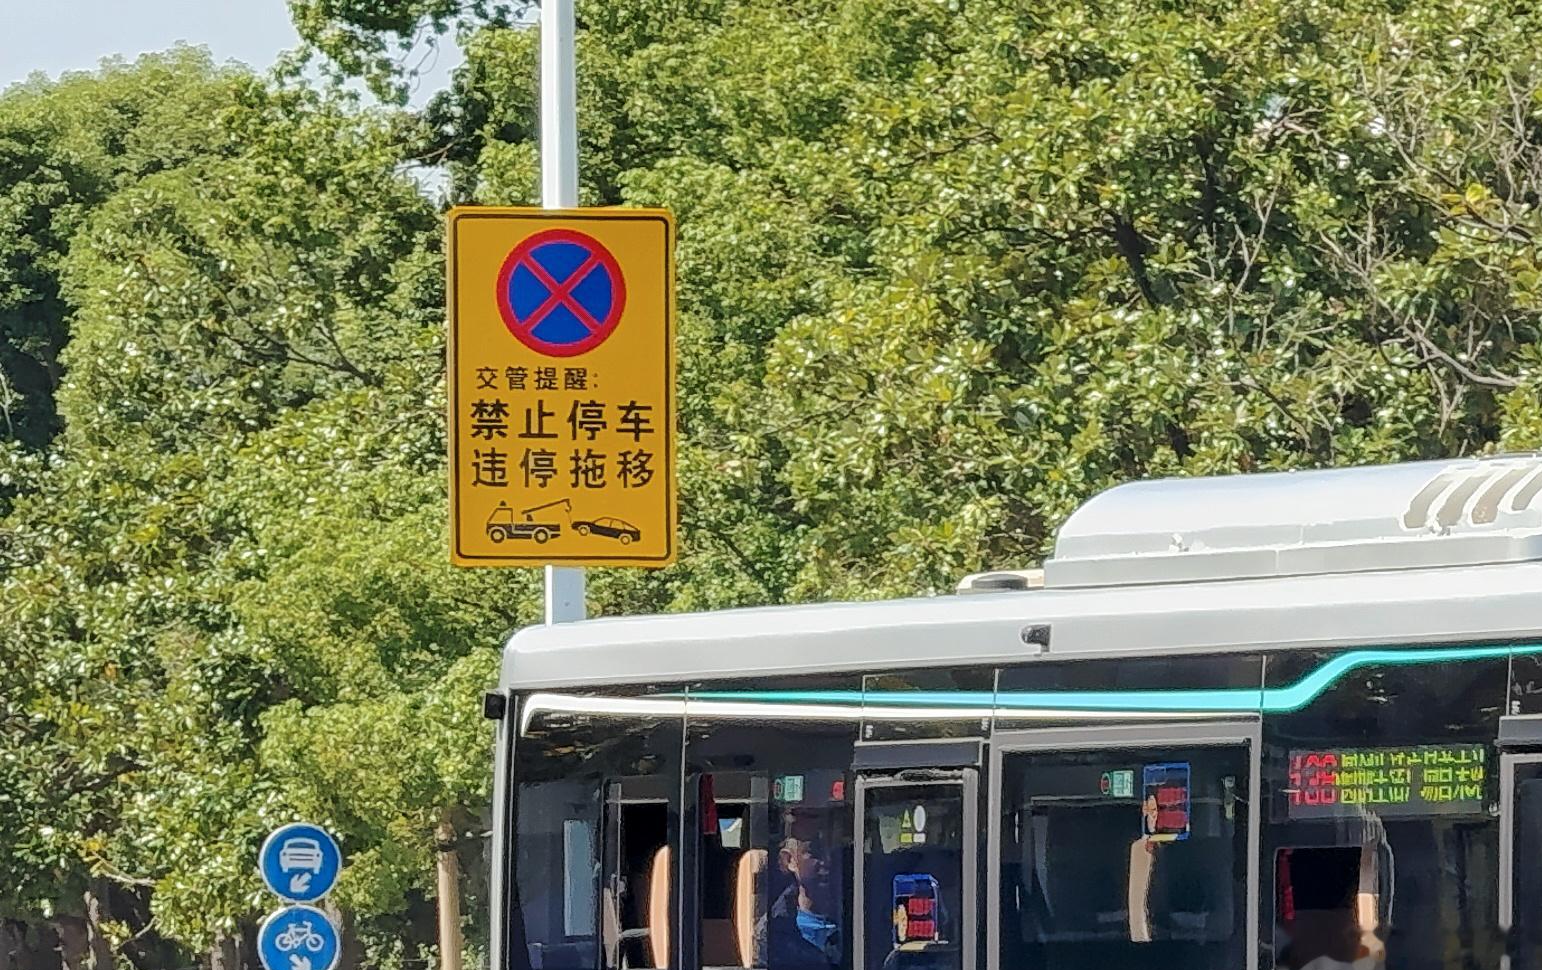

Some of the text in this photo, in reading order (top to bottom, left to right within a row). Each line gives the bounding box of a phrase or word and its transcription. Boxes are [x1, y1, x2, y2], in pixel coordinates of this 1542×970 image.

[470, 398, 655, 442] 禁止停车
[472, 447, 655, 489] 违停拖移
